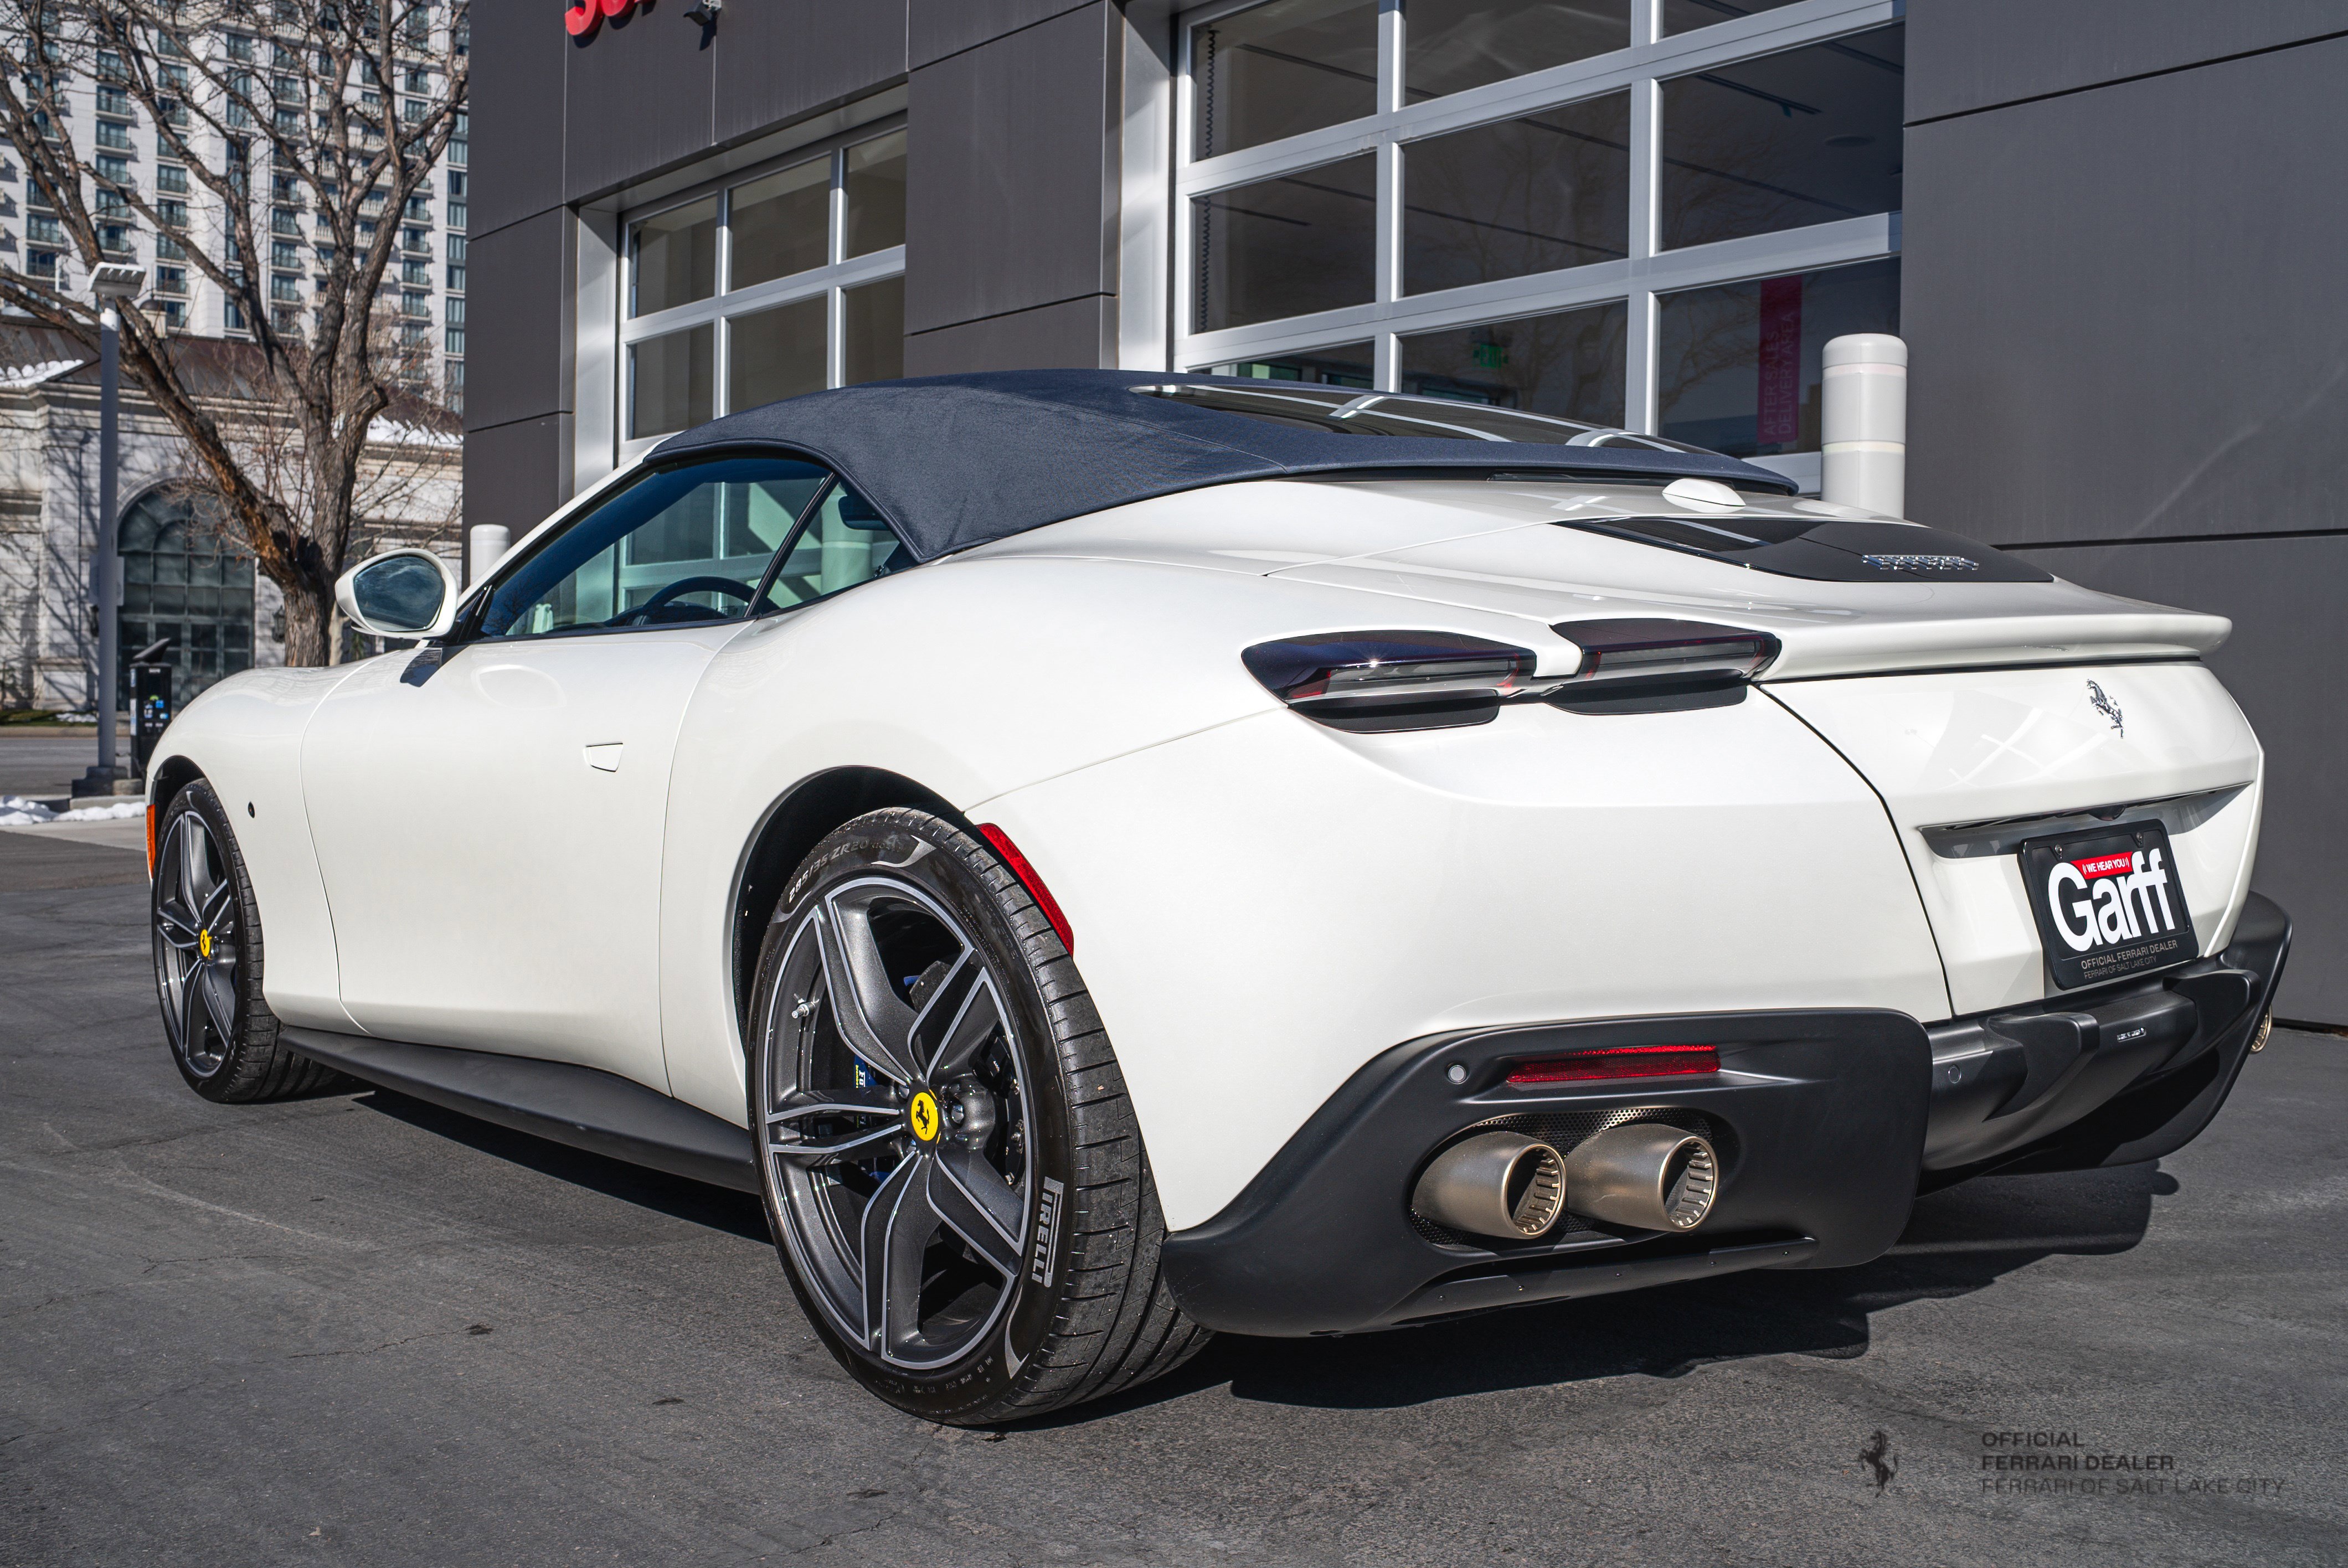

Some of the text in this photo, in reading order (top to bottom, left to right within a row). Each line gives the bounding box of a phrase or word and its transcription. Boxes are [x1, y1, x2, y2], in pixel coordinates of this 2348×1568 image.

[1764, 331, 1779, 435] AFTER SALES
[1778, 312, 1794, 435] DELIVERY AREA
[789, 839, 869, 904] 285/35 ZR20
[2048, 848, 2175, 951] Garff
[2087, 859, 2125, 873] WE HEAR YOU
[2081, 940, 2178, 969] OFFICIAL FERRARI DEALER
[2084, 968, 2108, 979] FERRARI
[2117, 962, 2130, 972] SALT
[2130, 958, 2145, 968] LAKE
[2144, 956, 2157, 964] CITY
[1032, 1176, 1064, 1288] PIRELLI
